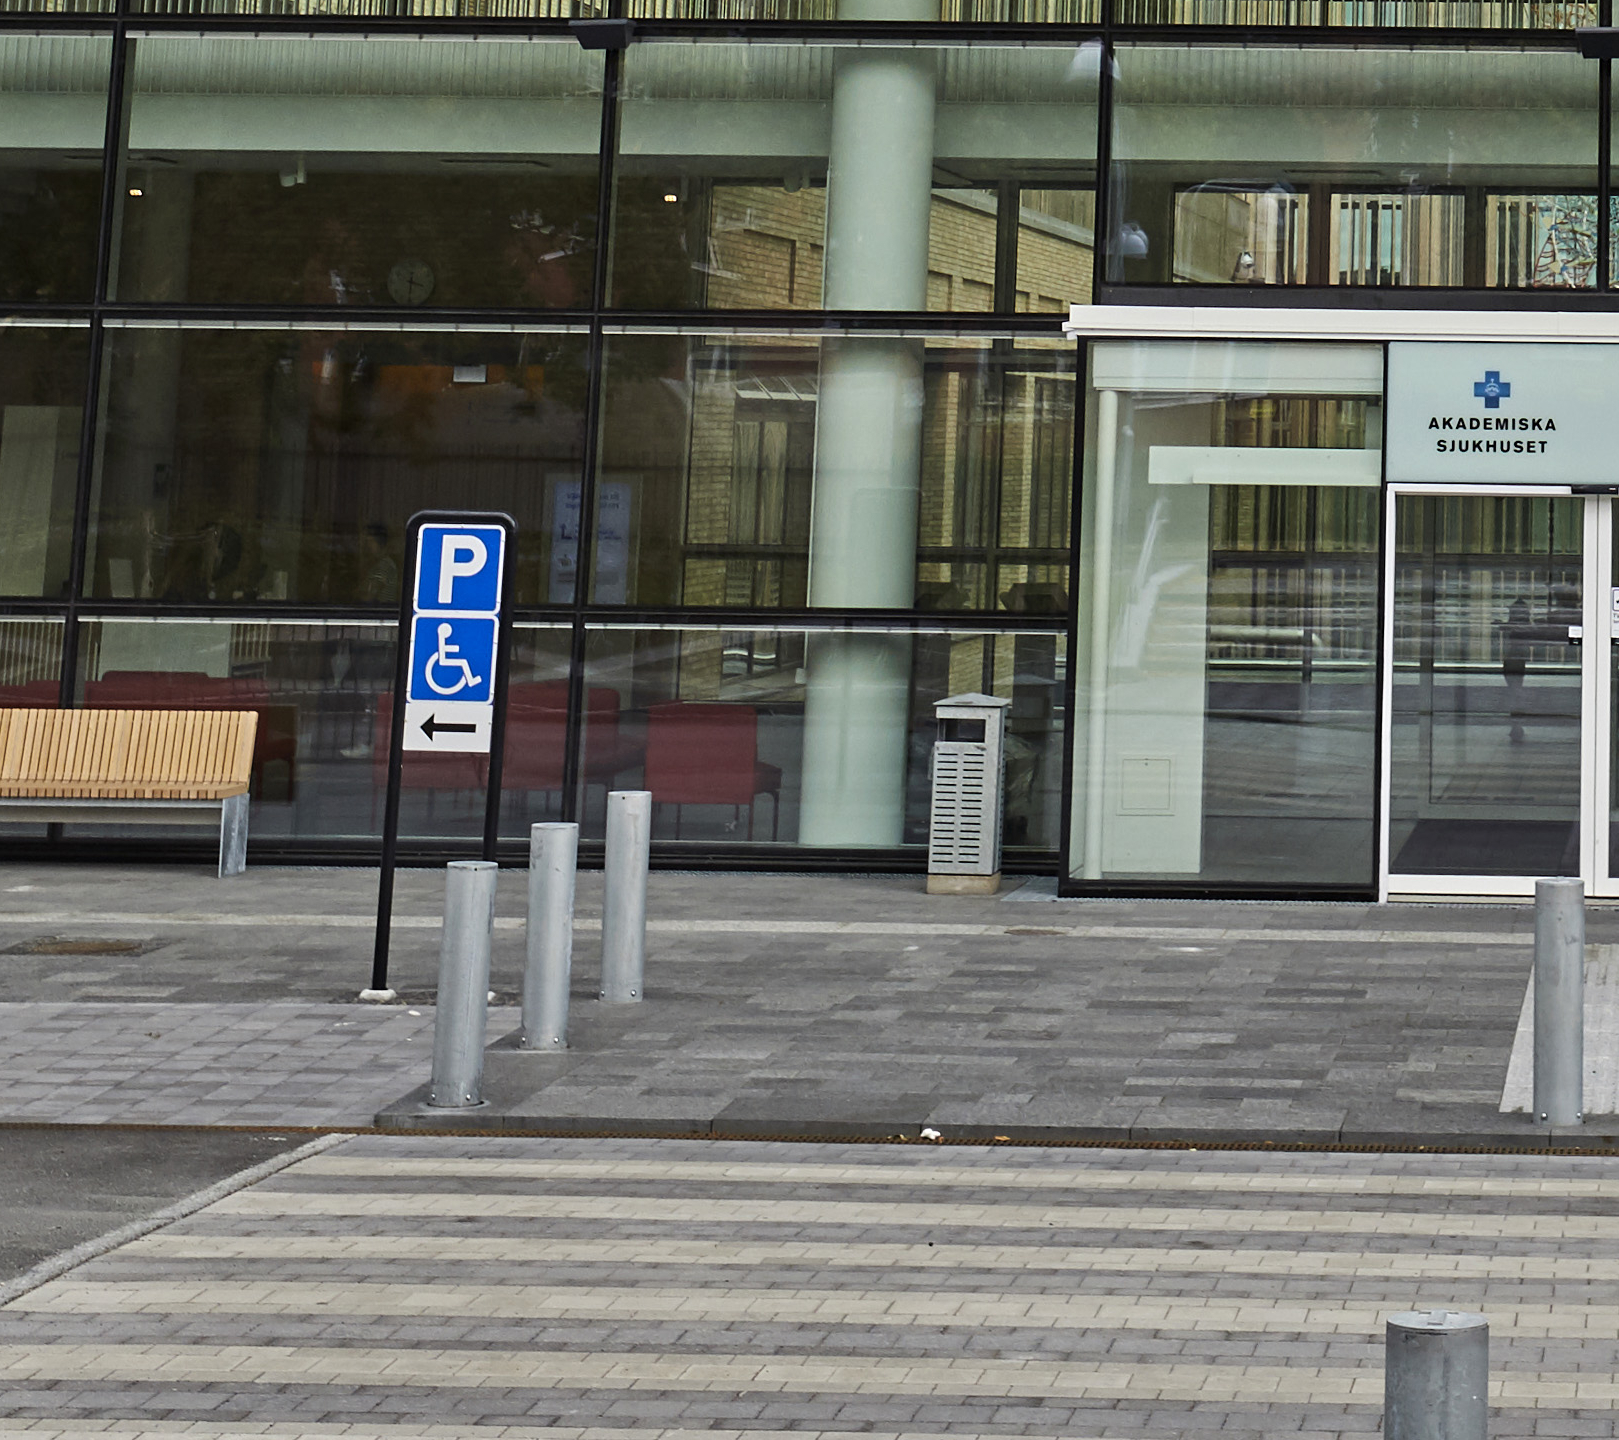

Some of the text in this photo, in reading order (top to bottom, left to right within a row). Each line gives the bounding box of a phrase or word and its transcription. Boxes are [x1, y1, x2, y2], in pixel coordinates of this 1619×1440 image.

[1428, 417, 1557, 431] AKADEMISKA
[1436, 439, 1549, 453] SJUKHUSET
[438, 534, 488, 604] P
